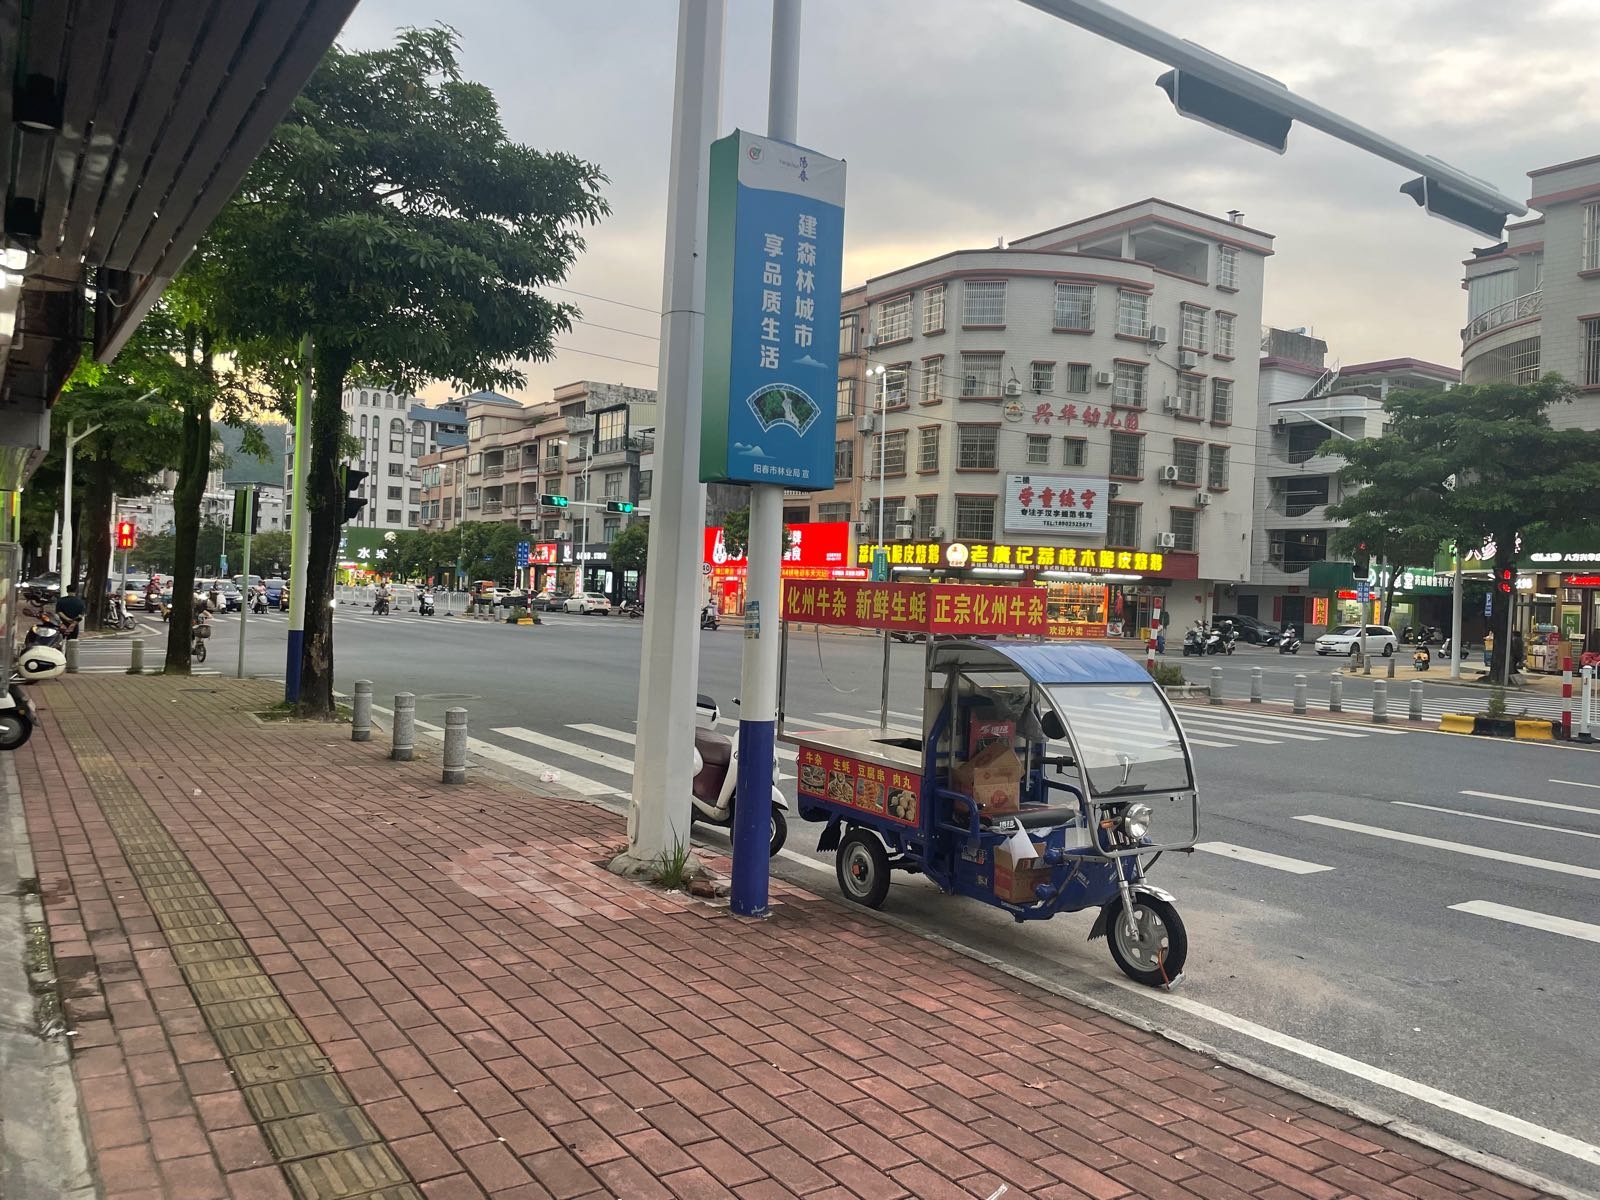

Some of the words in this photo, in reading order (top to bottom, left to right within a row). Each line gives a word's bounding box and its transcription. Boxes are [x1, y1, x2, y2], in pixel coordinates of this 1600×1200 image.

[795, 214, 817, 347] 建森林城市
[760, 233, 784, 369] 享品质生活
[1032, 403, 1138, 431] 兴华幼儿园
[753, 463, 800, 478] 阳春市林业局
[802, 469, 810, 479] 宣
[787, 586, 847, 617] 化州牛杂
[856, 589, 927, 623] 新鲜生蚝
[934, 593, 1044, 626] 正宗化州牛杂
[1049, 625, 1083, 636] 欢迎外卖
[806, 751, 823, 766] 牛杂
[833, 758, 851, 773] 生蚝
[892, 774, 912, 790] 肉丸
